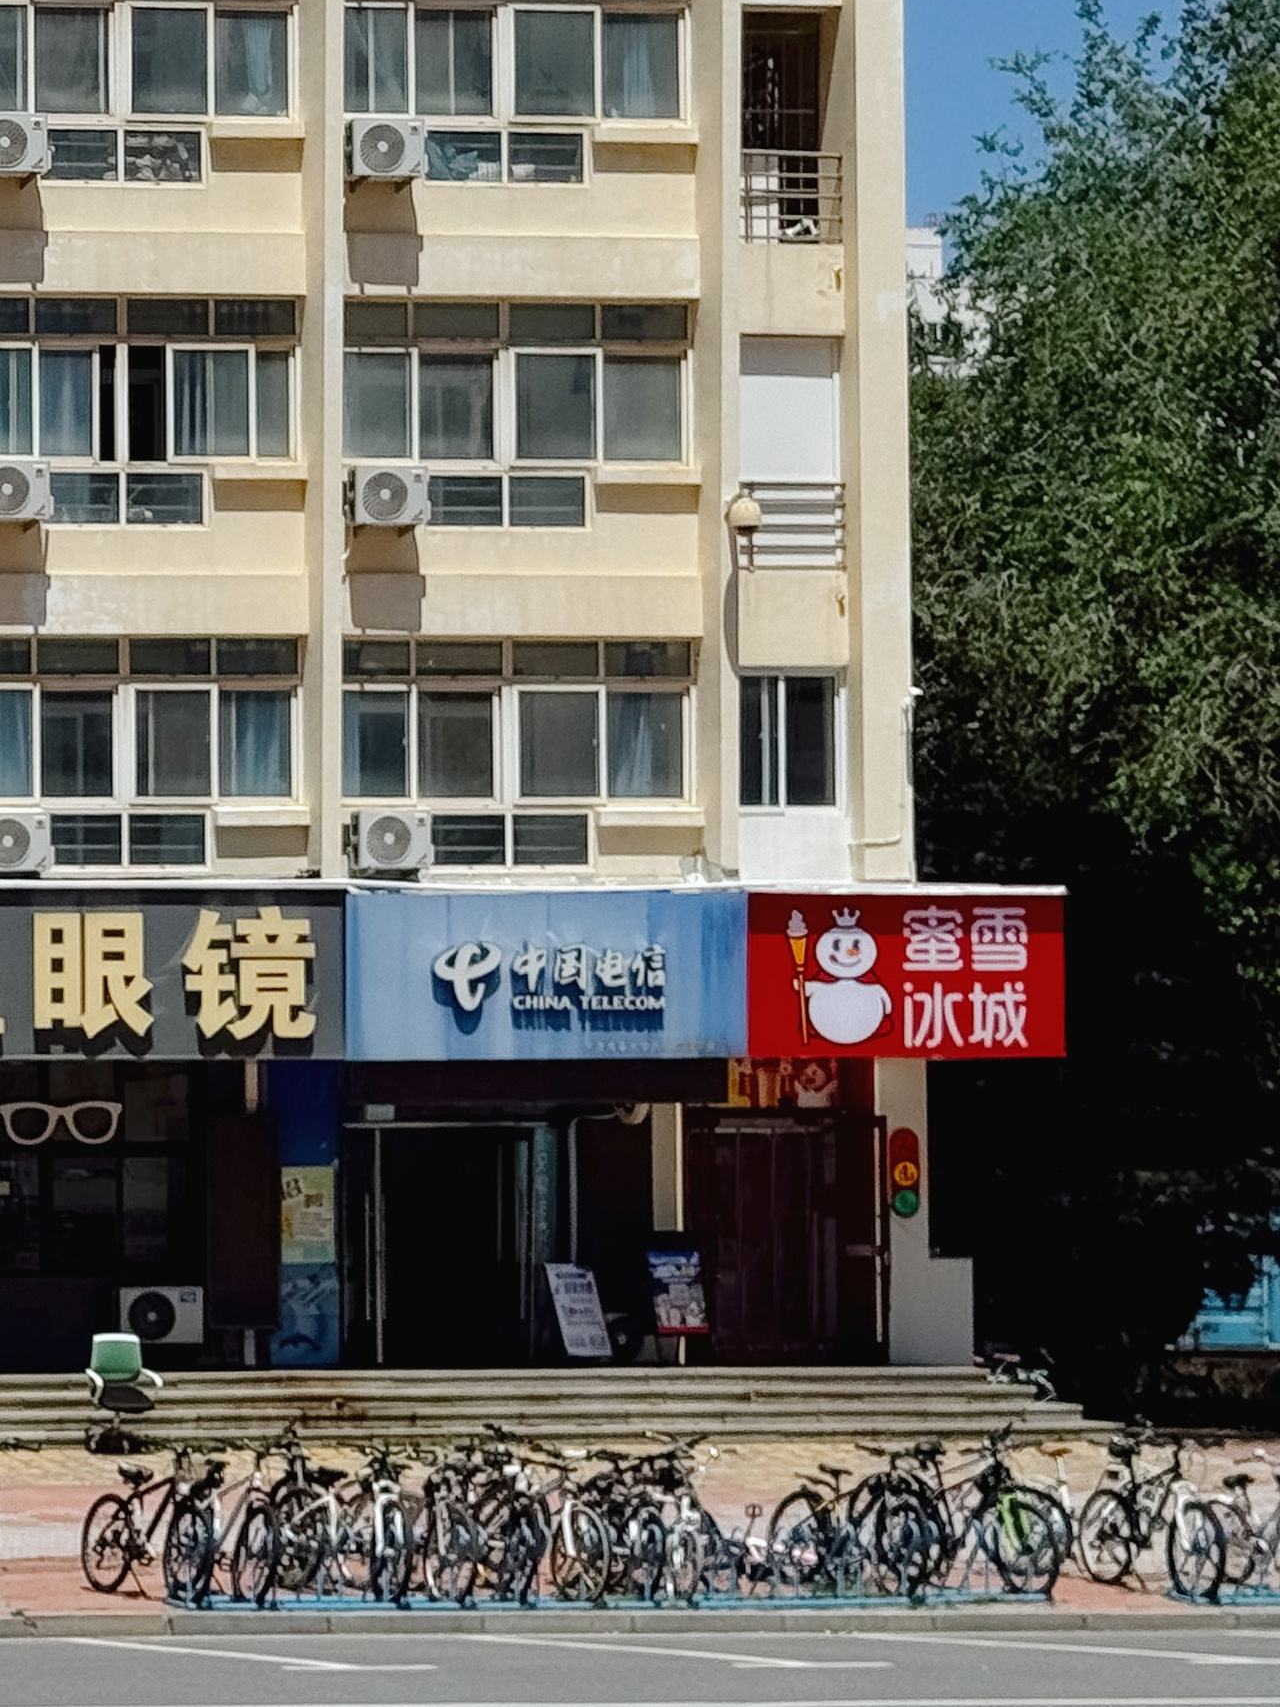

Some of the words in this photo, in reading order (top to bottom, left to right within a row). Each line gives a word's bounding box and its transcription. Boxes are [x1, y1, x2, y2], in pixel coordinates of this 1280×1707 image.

[902, 905, 1029, 972] 蜜雪
[513, 944, 667, 992] 中国电信
[513, 995, 571, 1010] CHINA
[579, 995, 666, 1010] TELECOM
[902, 980, 1029, 1049] 冰城
